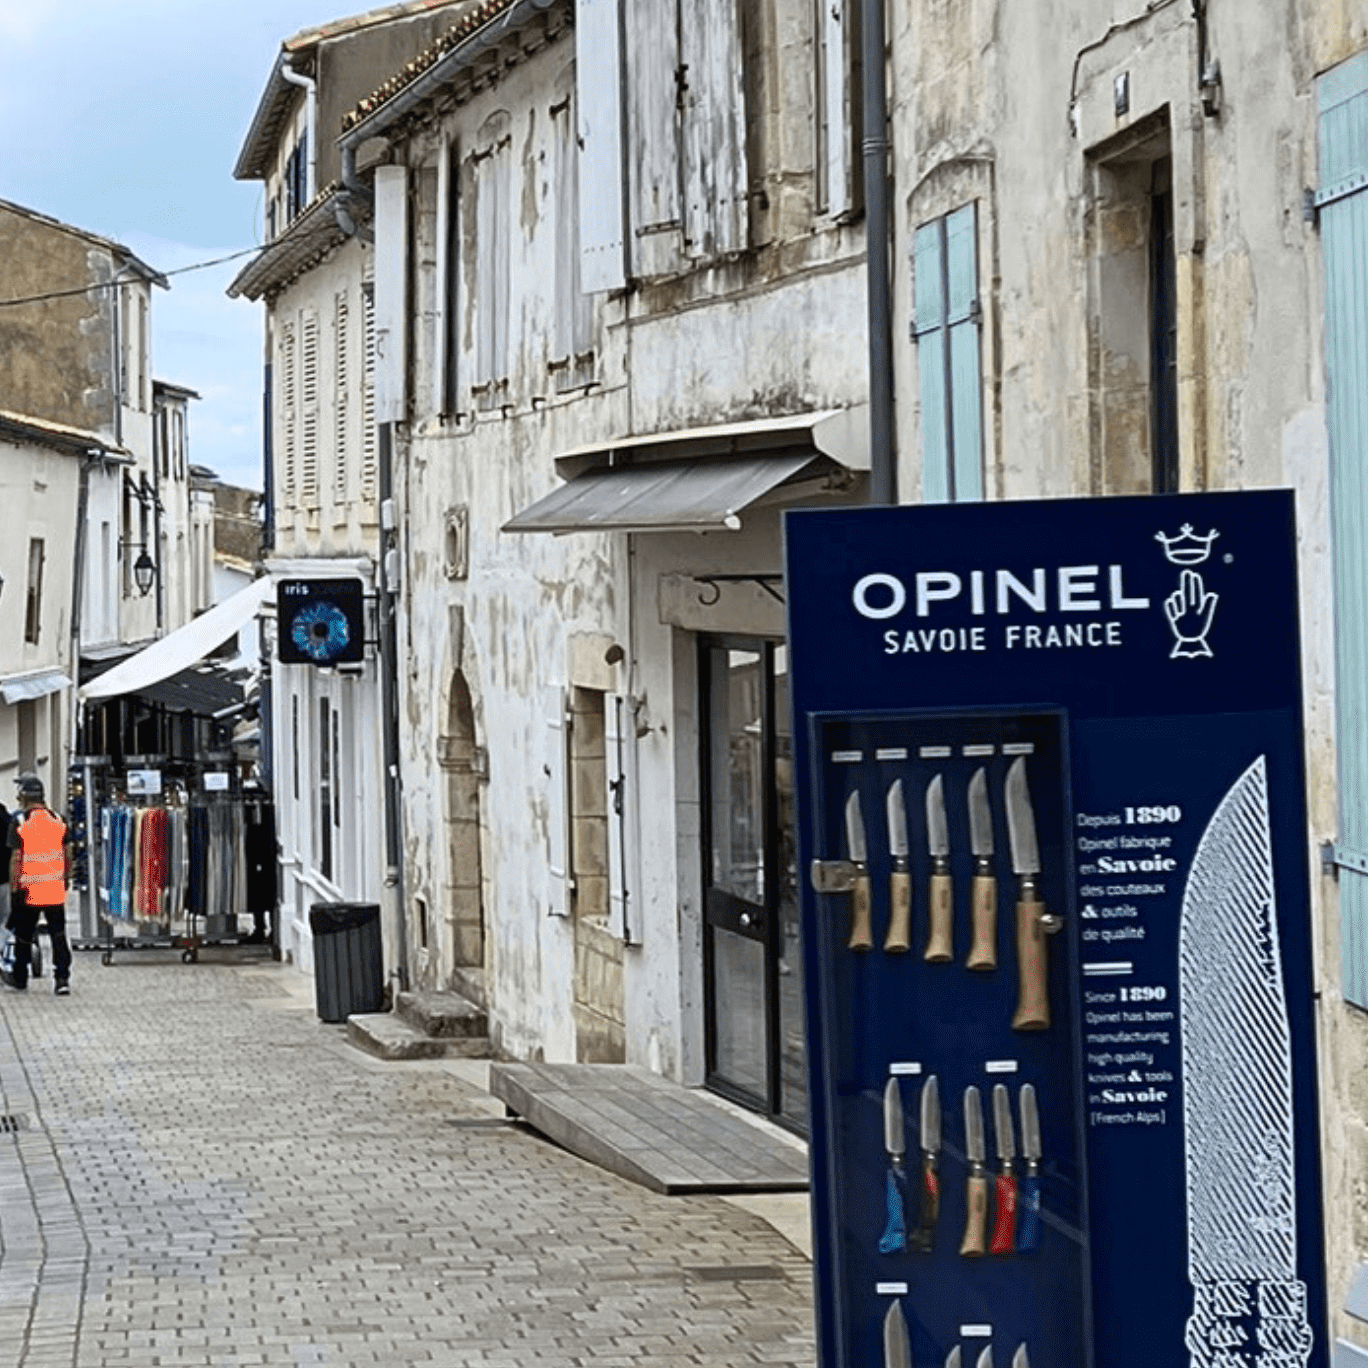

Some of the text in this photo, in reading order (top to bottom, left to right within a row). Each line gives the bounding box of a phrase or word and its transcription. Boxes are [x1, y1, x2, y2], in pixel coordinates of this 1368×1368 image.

[284, 581, 310, 596] iris
[852, 564, 1151, 620] OPINEL
[884, 621, 1123, 655] SAVOIE FRANCE
[1124, 804, 1182, 825] 1890
[1097, 854, 1177, 873] Savoie
[1081, 904, 1098, 919] &
[1119, 986, 1167, 1002] 1890
[1127, 1069, 1142, 1082] &
[1102, 1087, 1169, 1103] Savoie
